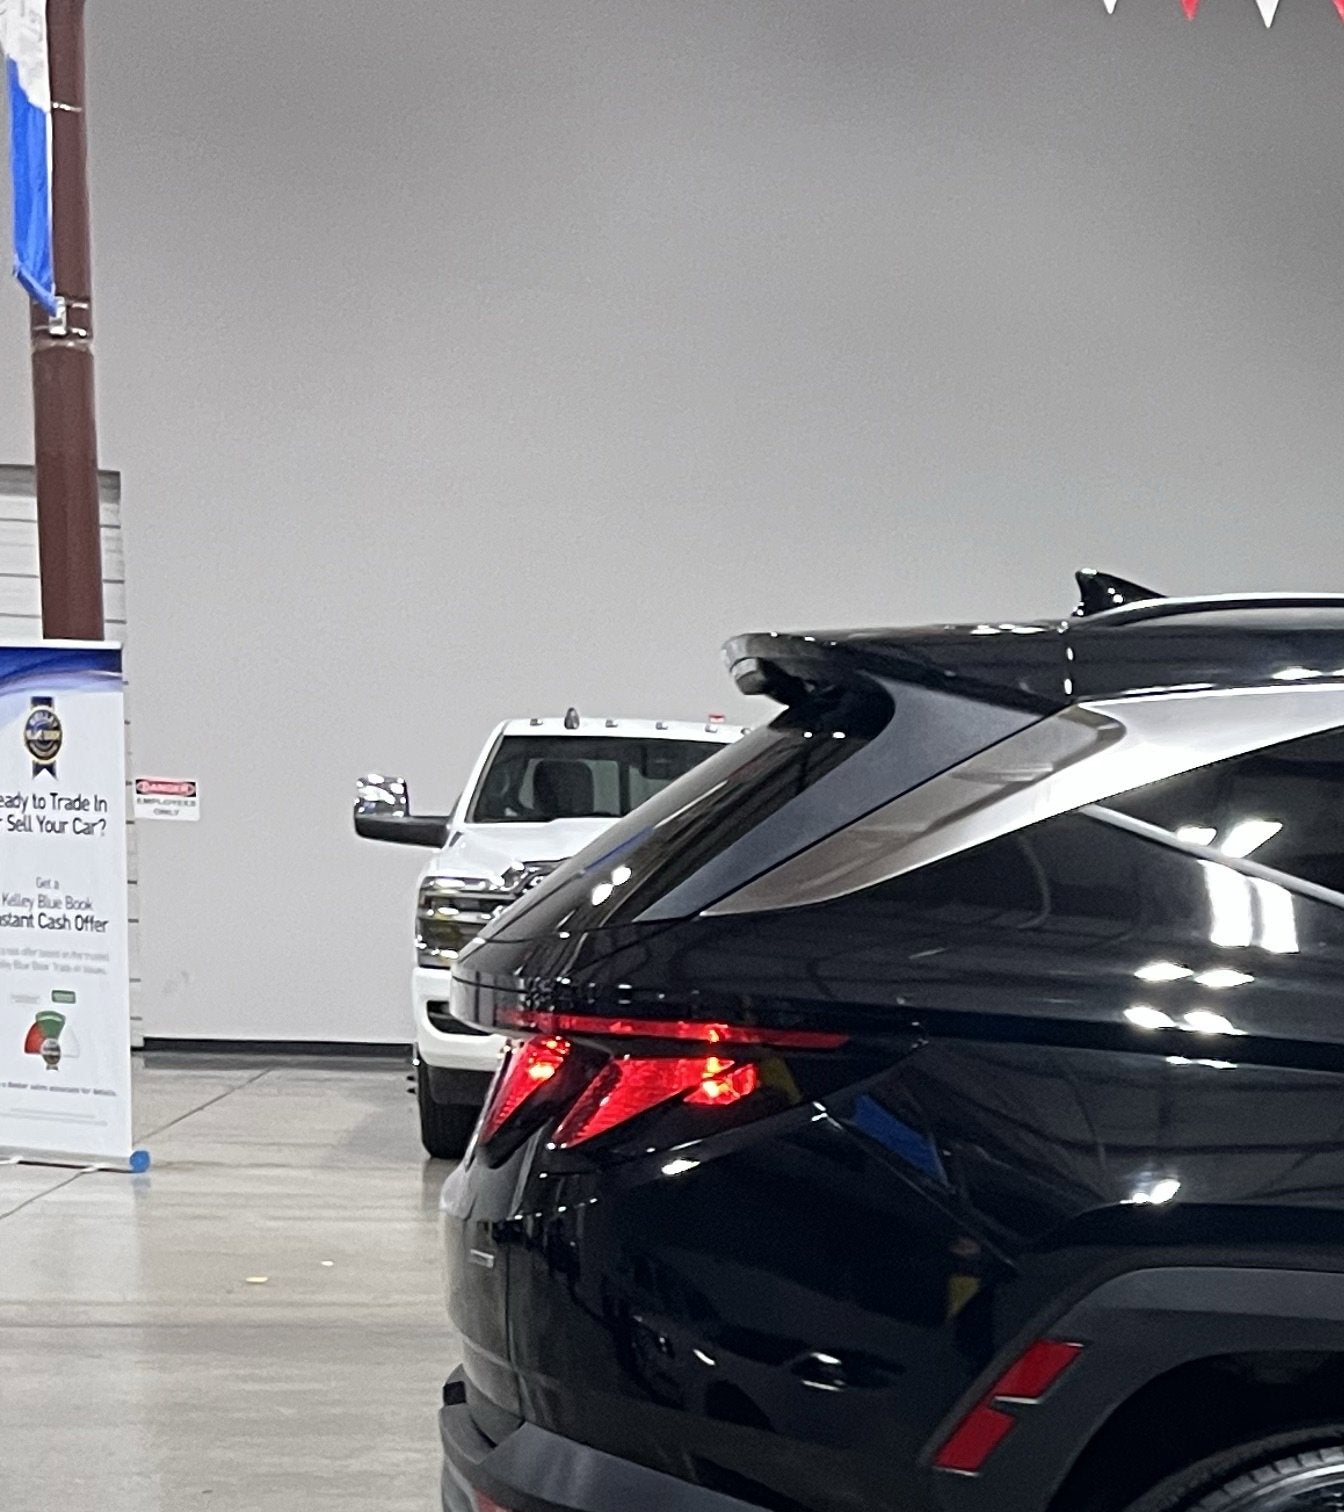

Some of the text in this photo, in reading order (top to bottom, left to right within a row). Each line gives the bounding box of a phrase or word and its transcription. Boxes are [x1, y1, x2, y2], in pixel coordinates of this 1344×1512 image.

[32, 793, 46, 810] to
[50, 792, 90, 812] Trade
[94, 794, 107, 813] In
[7, 814, 33, 833] Sell
[36, 815, 69, 834] Your
[72, 817, 107, 837] Car?
[37, 893, 62, 909] Blue
[65, 895, 93, 911] Book
[37, 912, 72, 930] Cash
[74, 914, 109, 932] Offer
